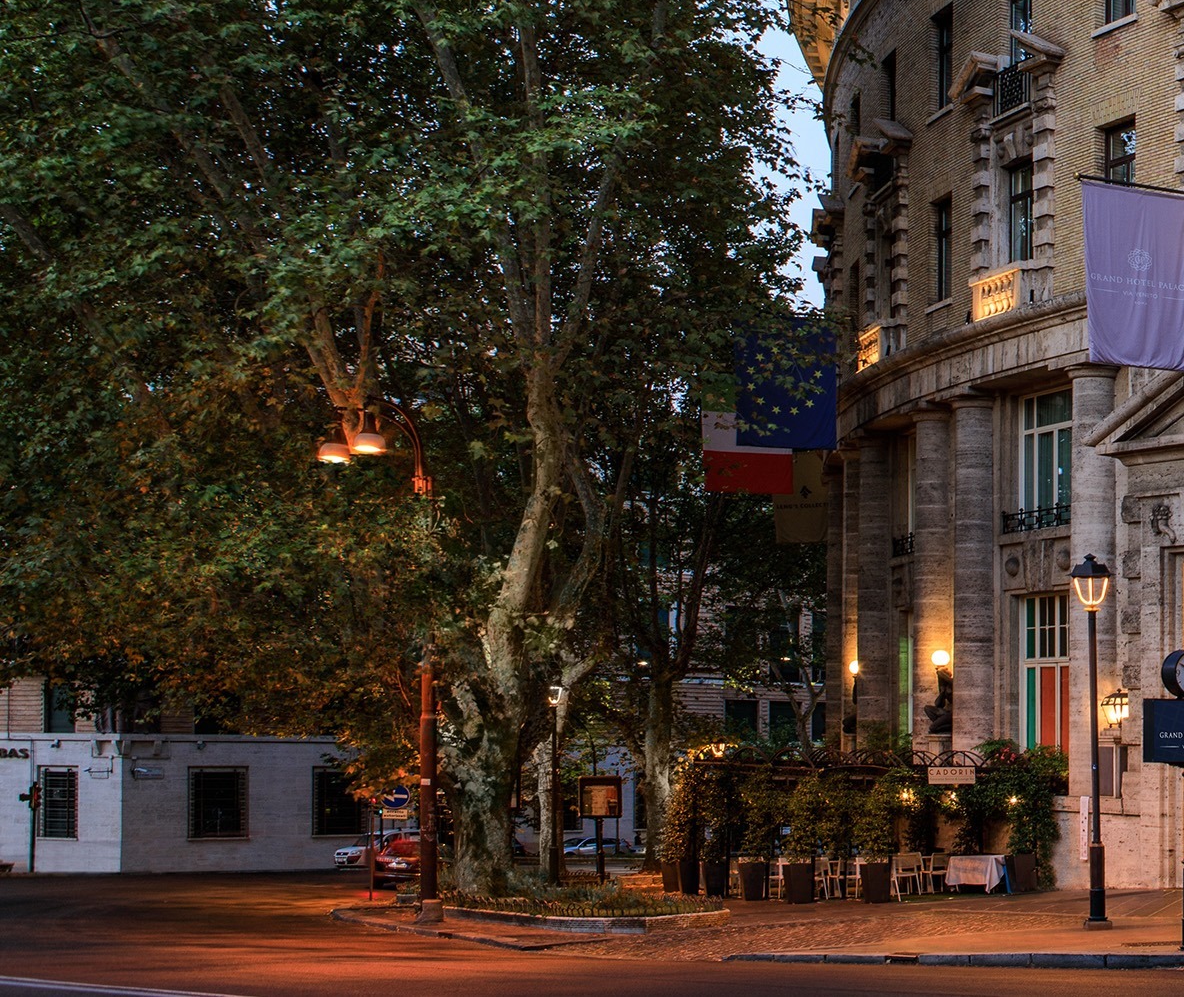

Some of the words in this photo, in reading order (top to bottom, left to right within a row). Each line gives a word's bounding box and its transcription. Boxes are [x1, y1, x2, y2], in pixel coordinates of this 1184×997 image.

[1090, 273, 1123, 284] GRAND
[1126, 278, 1156, 288] HOTEL
[1159, 731, 1183, 739] GRAND
[929, 768, 974, 776] CADORIN
